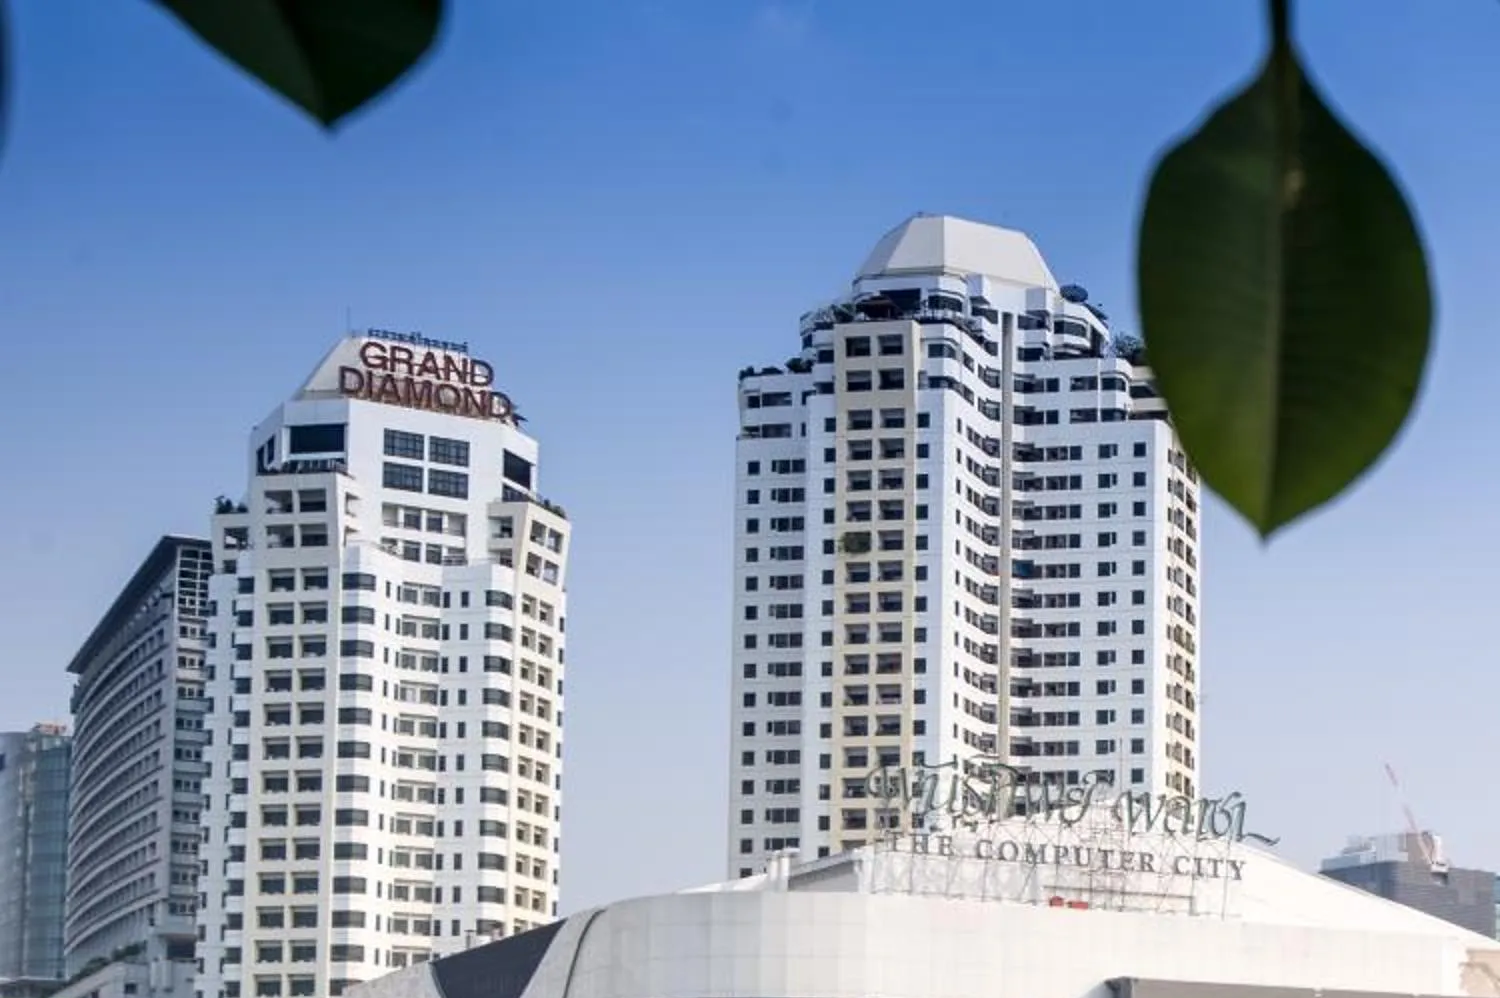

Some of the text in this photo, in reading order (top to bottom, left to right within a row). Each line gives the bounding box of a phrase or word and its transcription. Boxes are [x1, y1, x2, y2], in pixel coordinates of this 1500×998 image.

[359, 341, 495, 387] GRAND
[338, 365, 513, 419] DIAMOND
[888, 829, 1248, 882] THE COMPUTER CITY
